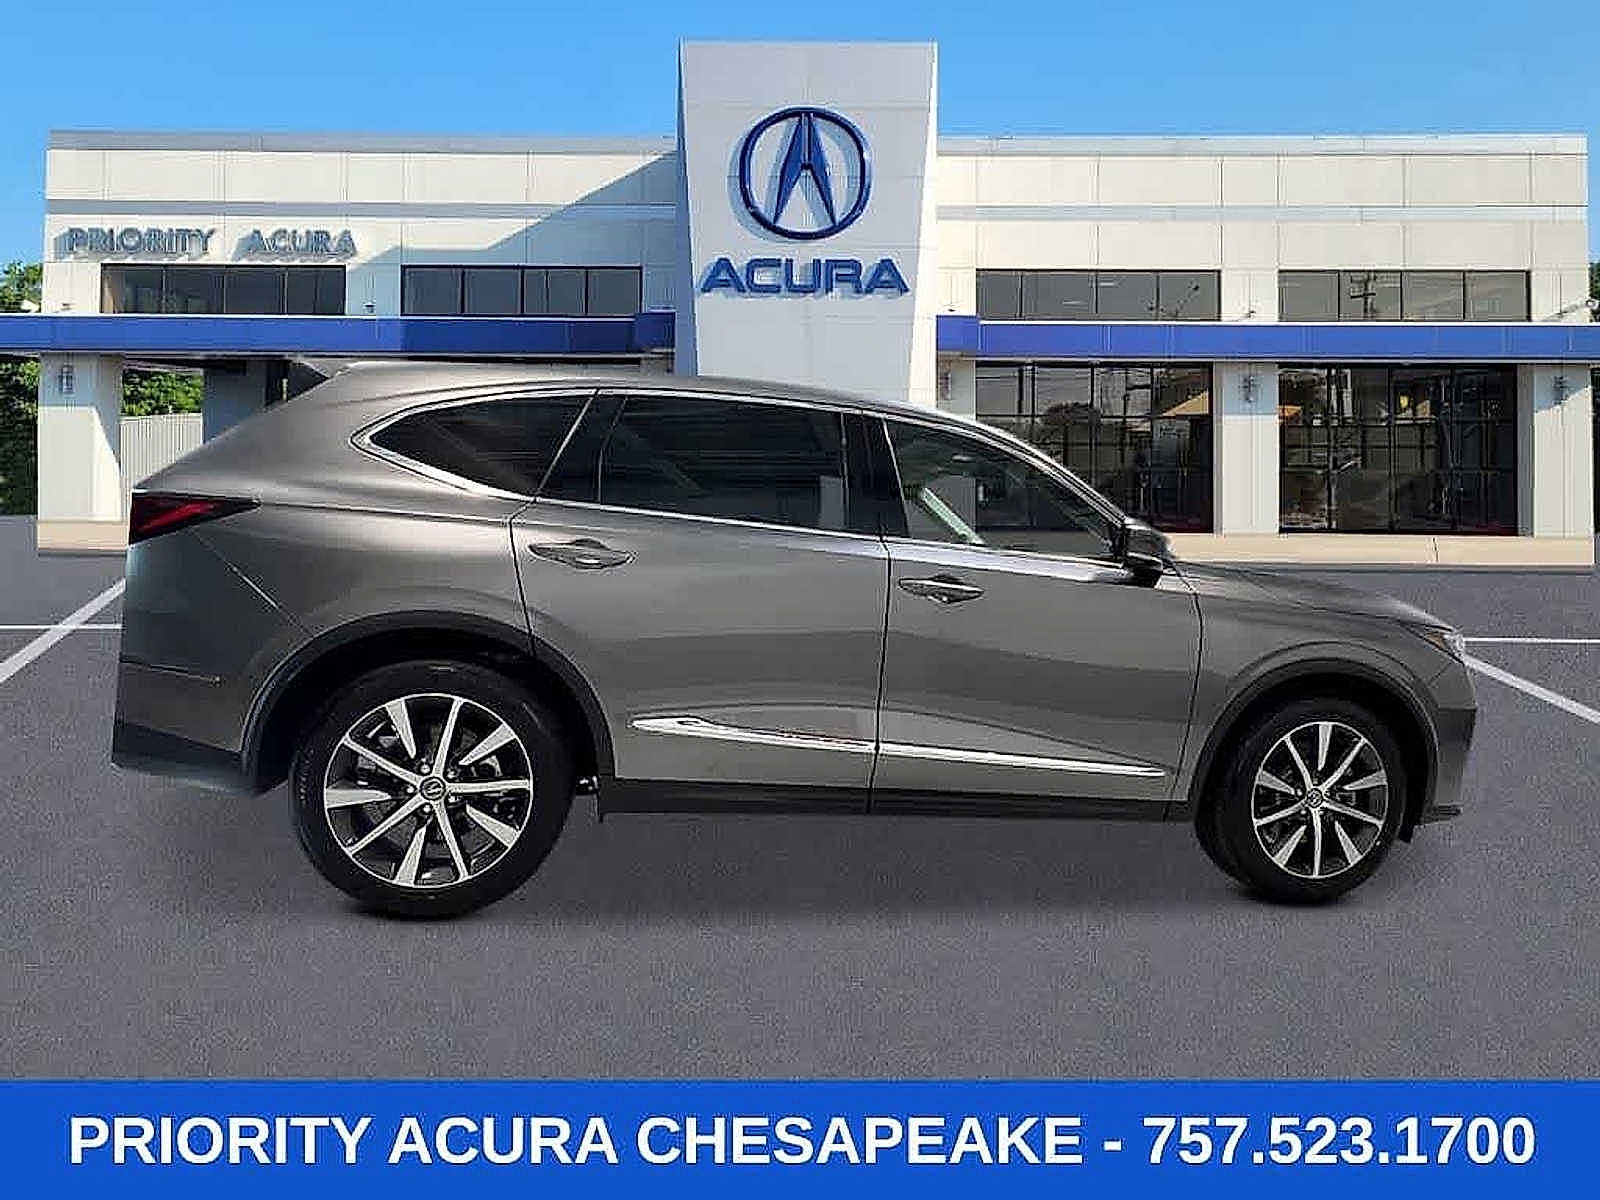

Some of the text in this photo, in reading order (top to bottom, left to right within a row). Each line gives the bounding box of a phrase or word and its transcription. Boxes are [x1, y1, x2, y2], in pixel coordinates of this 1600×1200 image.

[66, 227, 357, 254] PRIORITY ACURA
[700, 257, 909, 295] ACURA
